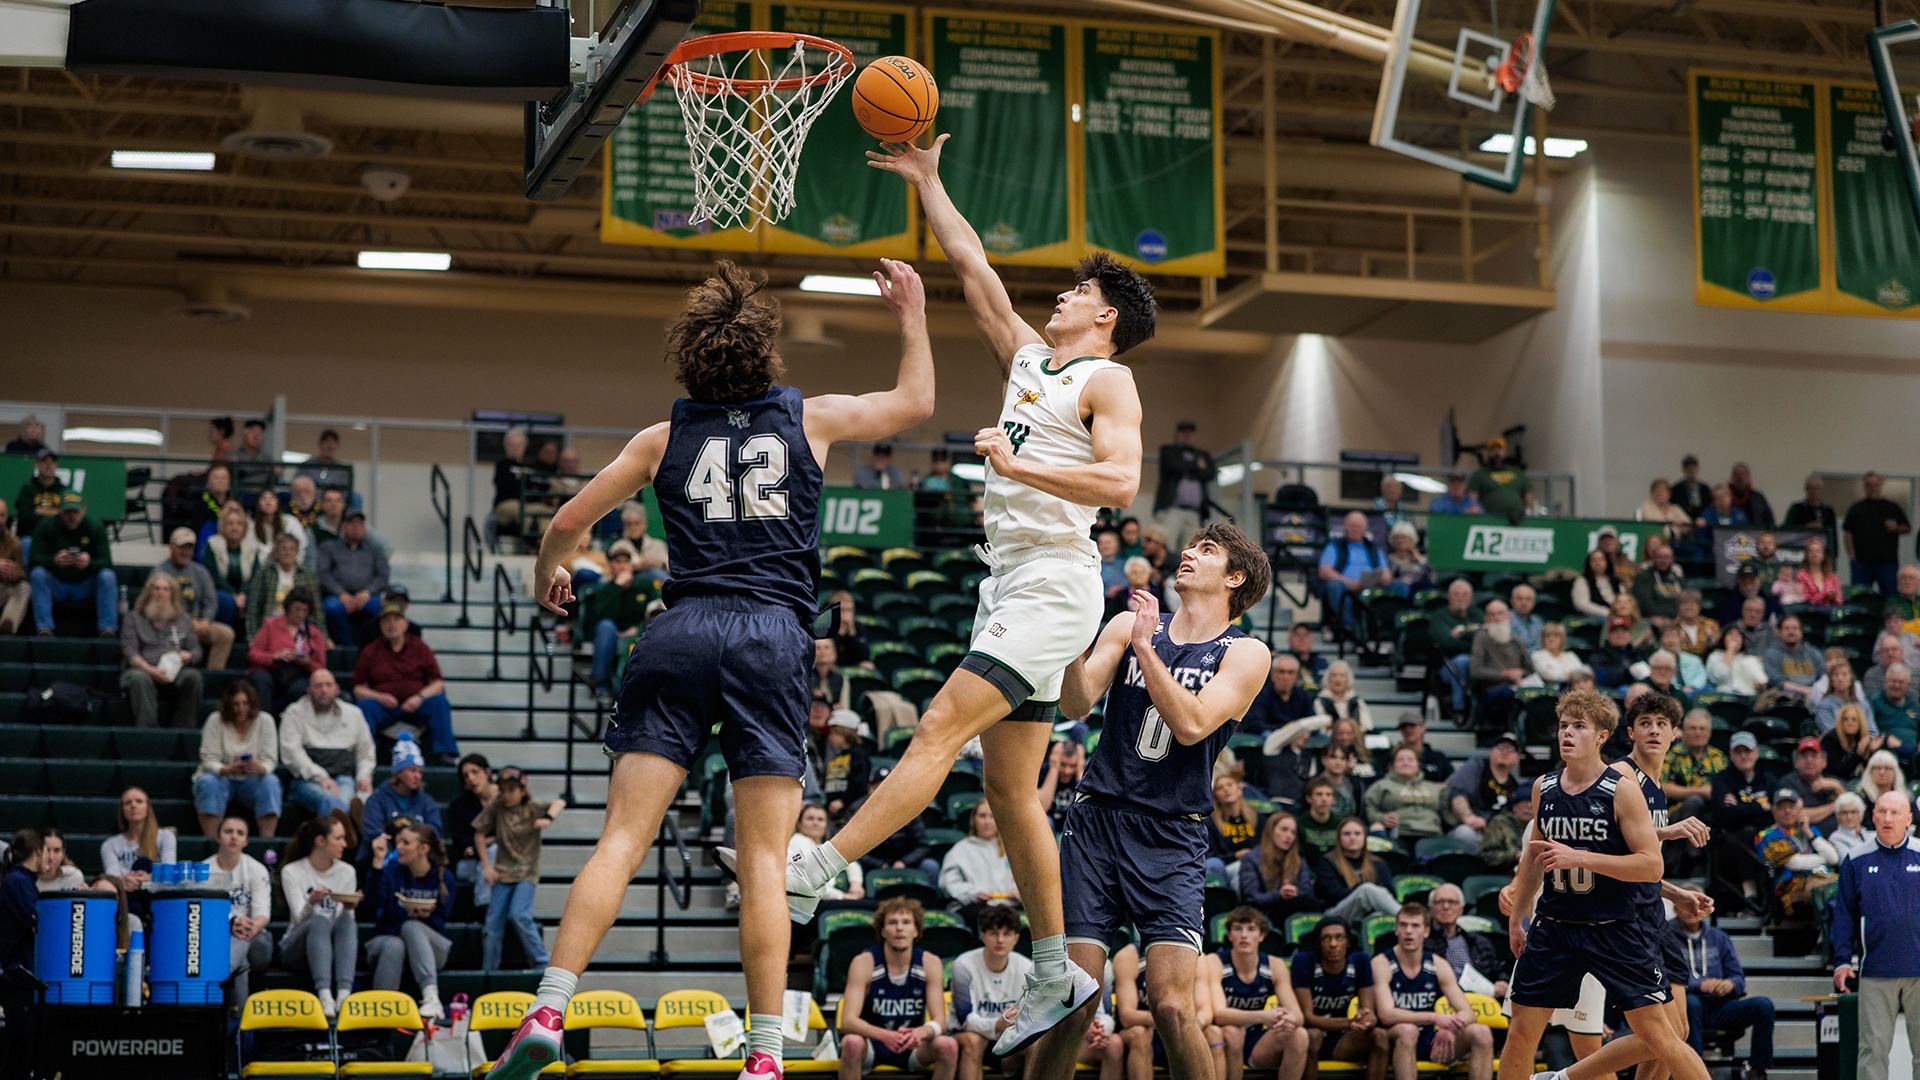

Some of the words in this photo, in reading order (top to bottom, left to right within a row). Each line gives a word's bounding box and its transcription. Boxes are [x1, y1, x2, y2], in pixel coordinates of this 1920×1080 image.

[885, 57, 917, 81] NCAA
[684, 433, 790, 523] 42
[823, 497, 883, 535] 102
[1135, 704, 1173, 762] 0
[1540, 816, 1608, 841] MINES
[71, 903, 85, 976] POWERADE
[187, 903, 201, 976] POWERADE
[251, 999, 315, 1017] BHSU
[347, 1000, 411, 1016] BHSU
[573, 1000, 634, 1017] BHSU
[872, 998, 924, 1016] MINES
[72, 1038, 184, 1056] POWERADE
